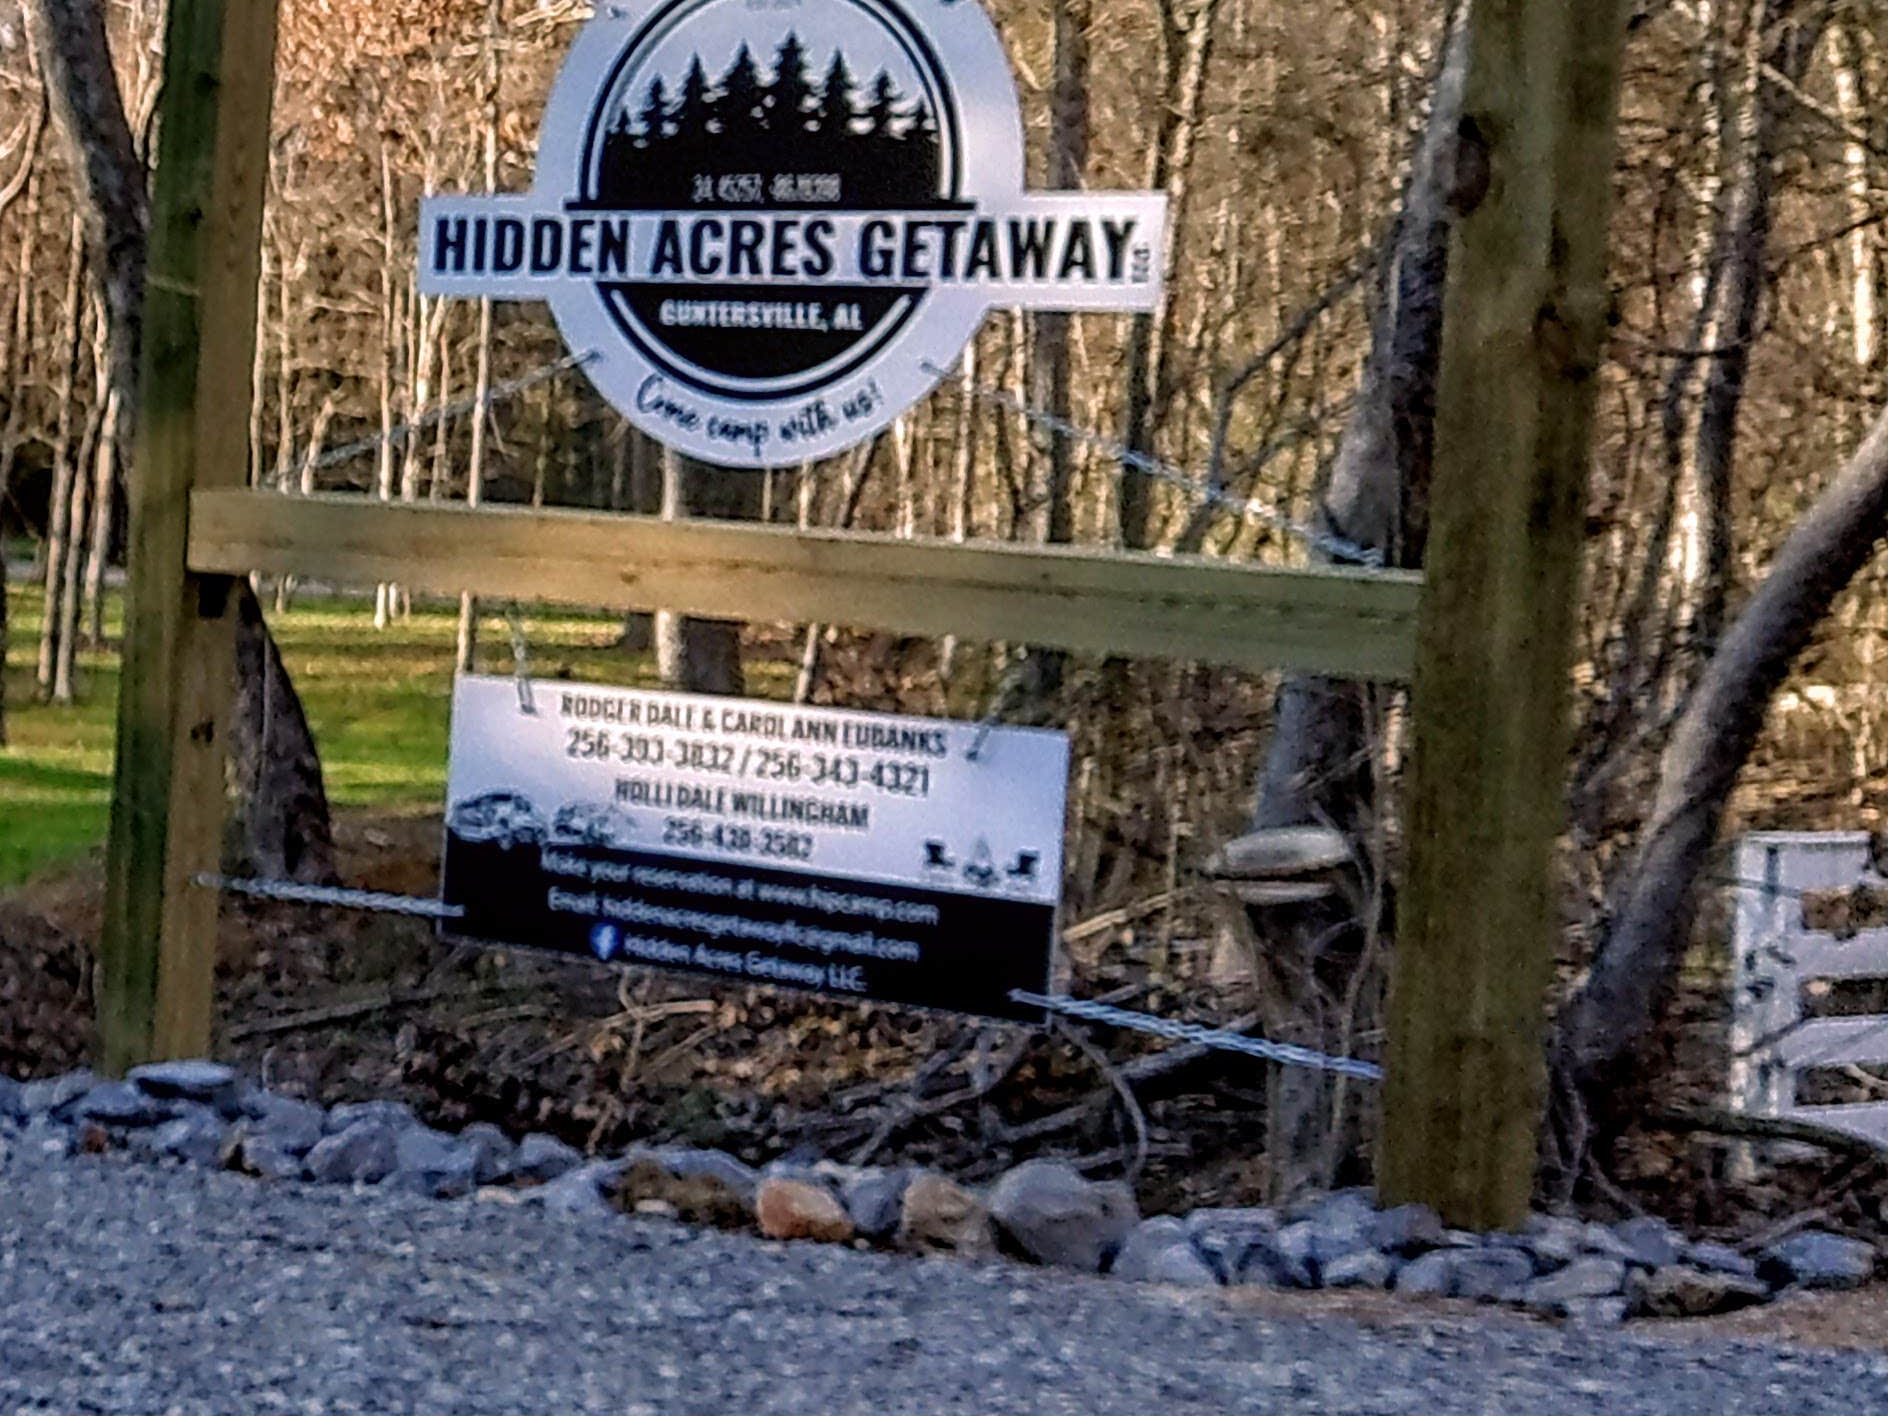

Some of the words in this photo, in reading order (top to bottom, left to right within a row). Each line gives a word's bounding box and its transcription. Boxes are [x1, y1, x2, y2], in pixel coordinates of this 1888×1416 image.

[433, 218, 630, 276] HIDDEN
[652, 219, 835, 276] ACRES
[859, 219, 1136, 280] GETAWAY
[658, 299, 828, 332] GUNTERSVILLE,
[833, 302, 864, 331] AL
[636, 372, 700, 432] Come
[705, 415, 772, 458] camp
[778, 397, 837, 442] with
[841, 376, 884, 424] us!
[561, 692, 642, 725] RODGER
[646, 701, 693, 731] DALE
[702, 707, 717, 732] &
[842, 719, 948, 758] EUBANKS
[731, 791, 870, 830] WILLINGHAM
[589, 860, 631, 884] your
[631, 865, 733, 896] reservation
[737, 879, 755, 901] at
[692, 942, 743, 974] Acres
[744, 949, 827, 989] Getaway
